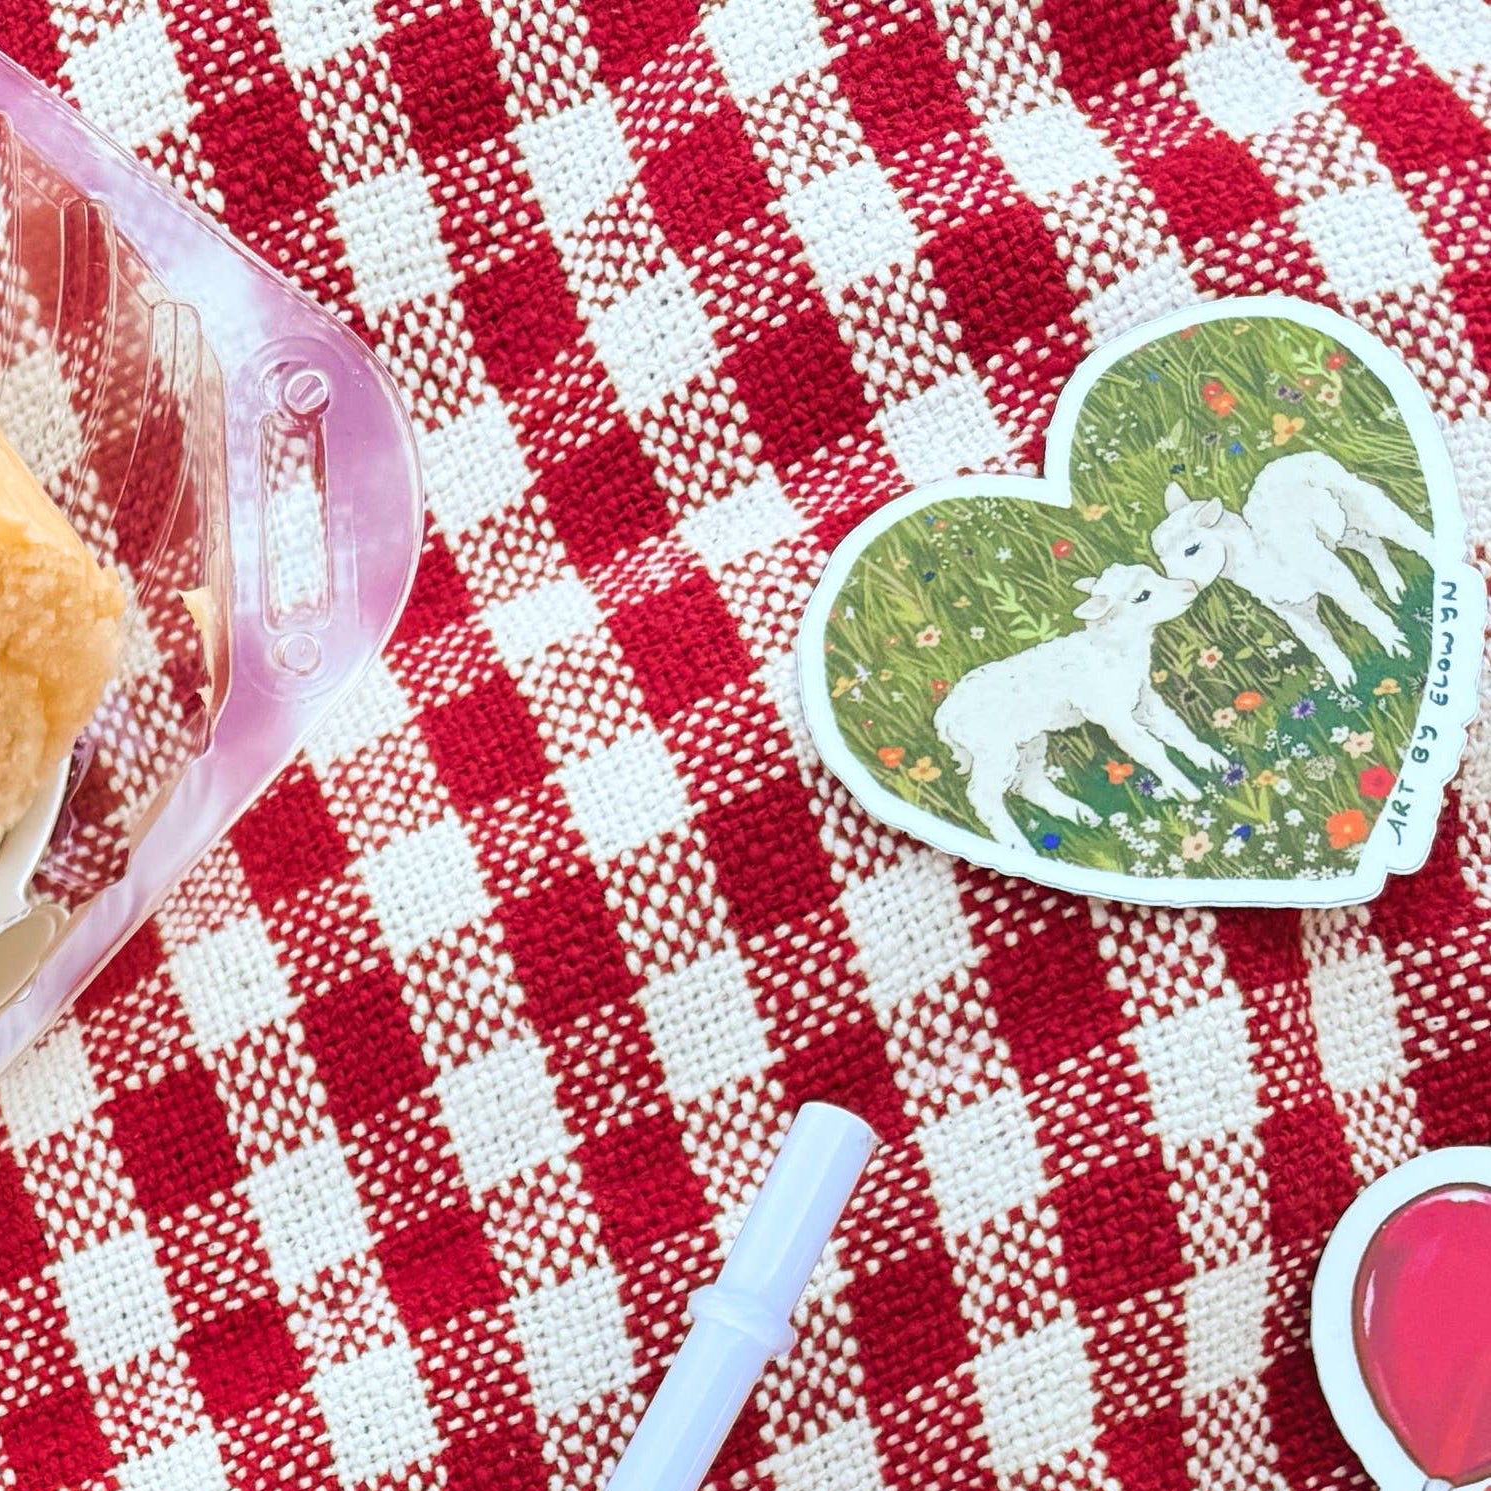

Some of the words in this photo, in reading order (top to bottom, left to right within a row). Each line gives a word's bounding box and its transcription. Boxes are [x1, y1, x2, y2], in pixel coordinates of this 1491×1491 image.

[1387, 778, 1415, 846] ART
[1411, 724, 1438, 763] BY
[1429, 580, 1459, 706] ELOWYN
